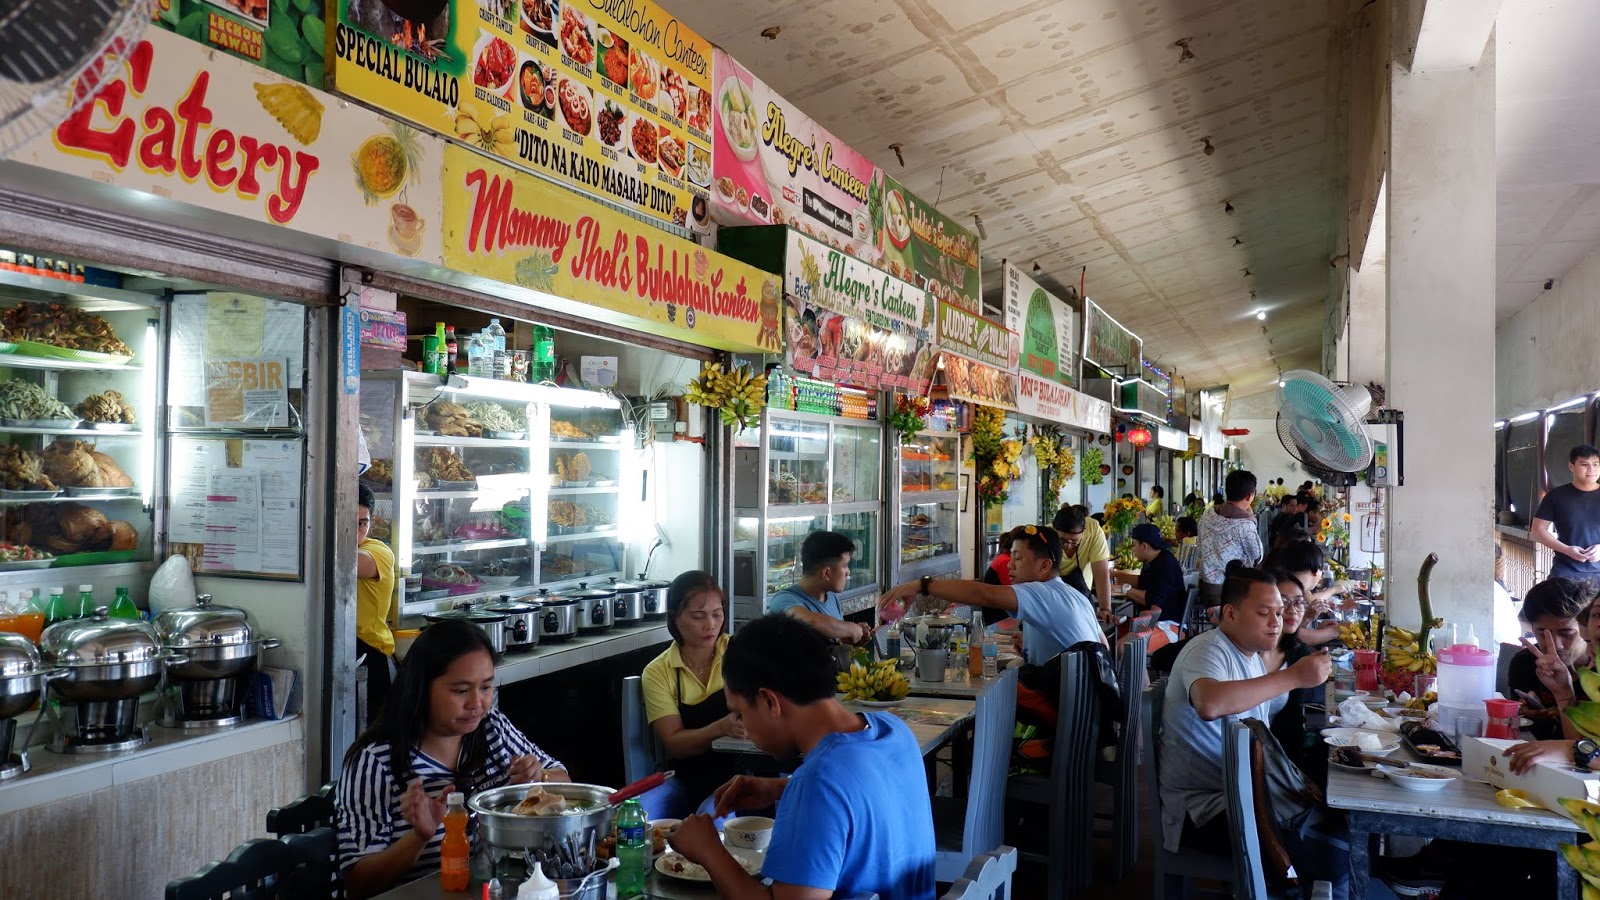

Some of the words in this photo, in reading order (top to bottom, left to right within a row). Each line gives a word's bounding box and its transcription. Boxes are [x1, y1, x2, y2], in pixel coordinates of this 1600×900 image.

[208, 12, 262, 45] LECHON
[208, 28, 262, 61] KAWALI
[588, 0, 660, 49] ulalohan
[664, 19, 707, 79] Canteen
[336, 22, 401, 89] SPECIAL
[404, 57, 459, 109] BULALO
[54, 35, 320, 225] Eatery
[475, 87, 487, 100] BEEF
[487, 92, 511, 113] CALDERETA
[551, 142, 568, 177] NA
[570, 150, 600, 188] KAYO
[601, 164, 650, 207] MASARAP
[761, 100, 819, 177] Alegre's
[820, 142, 869, 205] Canteen
[466, 167, 572, 263] Mommy
[635, 235, 711, 313] Bulalohan
[709, 267, 760, 325] Canteen
[823, 250, 879, 306] Alegre's
[881, 275, 918, 322] Canteen
[942, 306, 979, 345] JUDDIE'S
[243, 361, 283, 390] BIR
